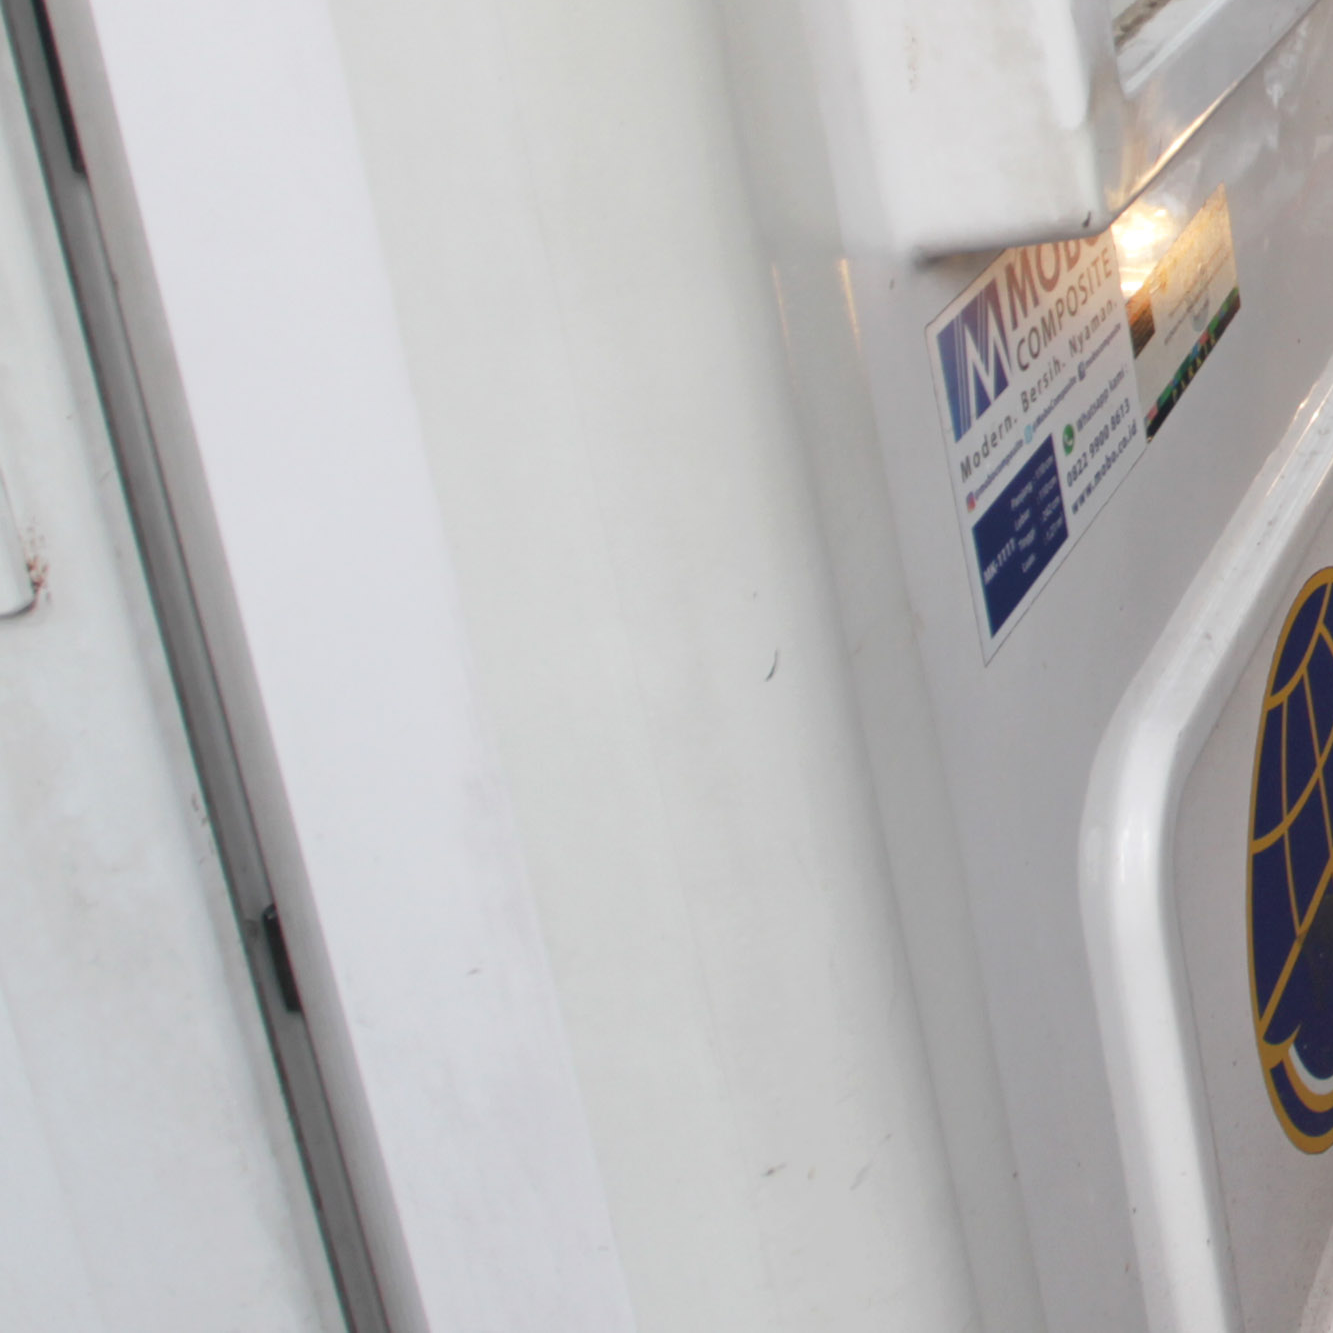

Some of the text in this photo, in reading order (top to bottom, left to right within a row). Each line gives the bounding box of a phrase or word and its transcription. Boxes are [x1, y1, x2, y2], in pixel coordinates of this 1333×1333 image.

[1005, 236, 1099, 331] MOB
[1016, 248, 1112, 372] COMPOSITE
[959, 414, 1018, 484] Modern.
[1066, 452, 1088, 488] 0822
